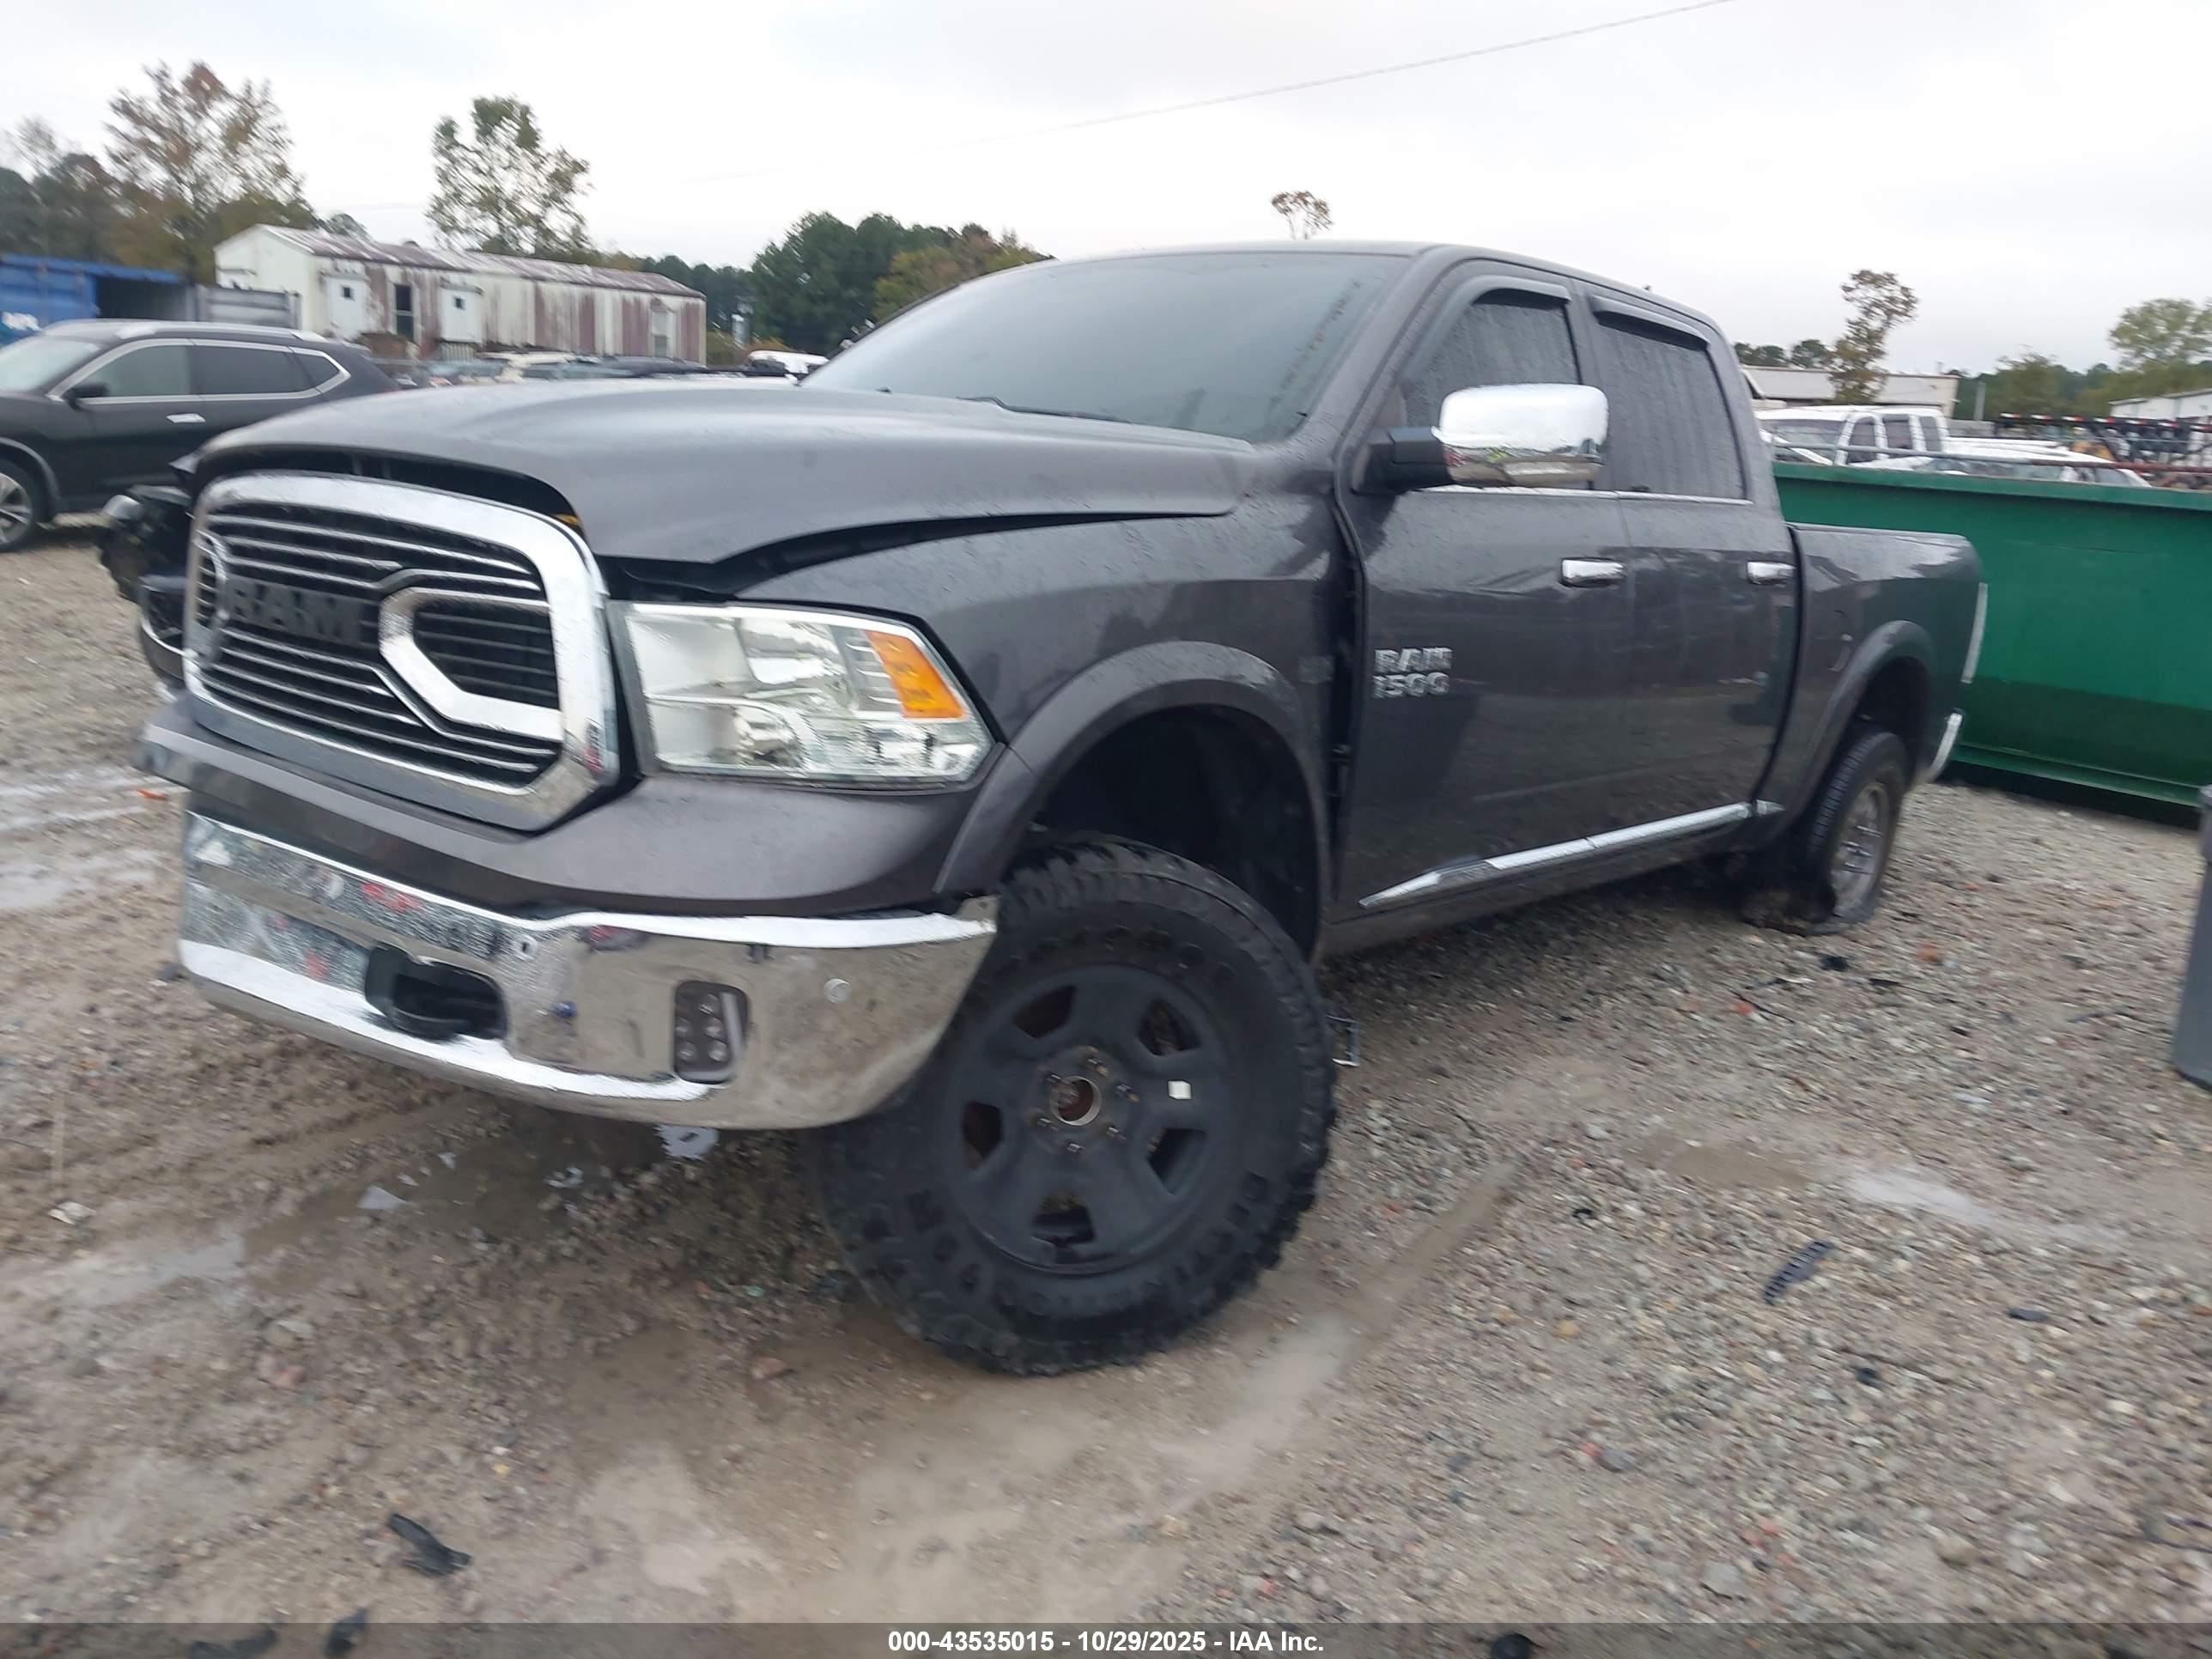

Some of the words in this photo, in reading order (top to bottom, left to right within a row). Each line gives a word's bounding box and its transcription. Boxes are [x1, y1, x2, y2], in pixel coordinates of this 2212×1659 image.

[226, 573, 362, 648] RAM
[1374, 647, 1453, 672] RAM
[1372, 672, 1450, 699] 1500
